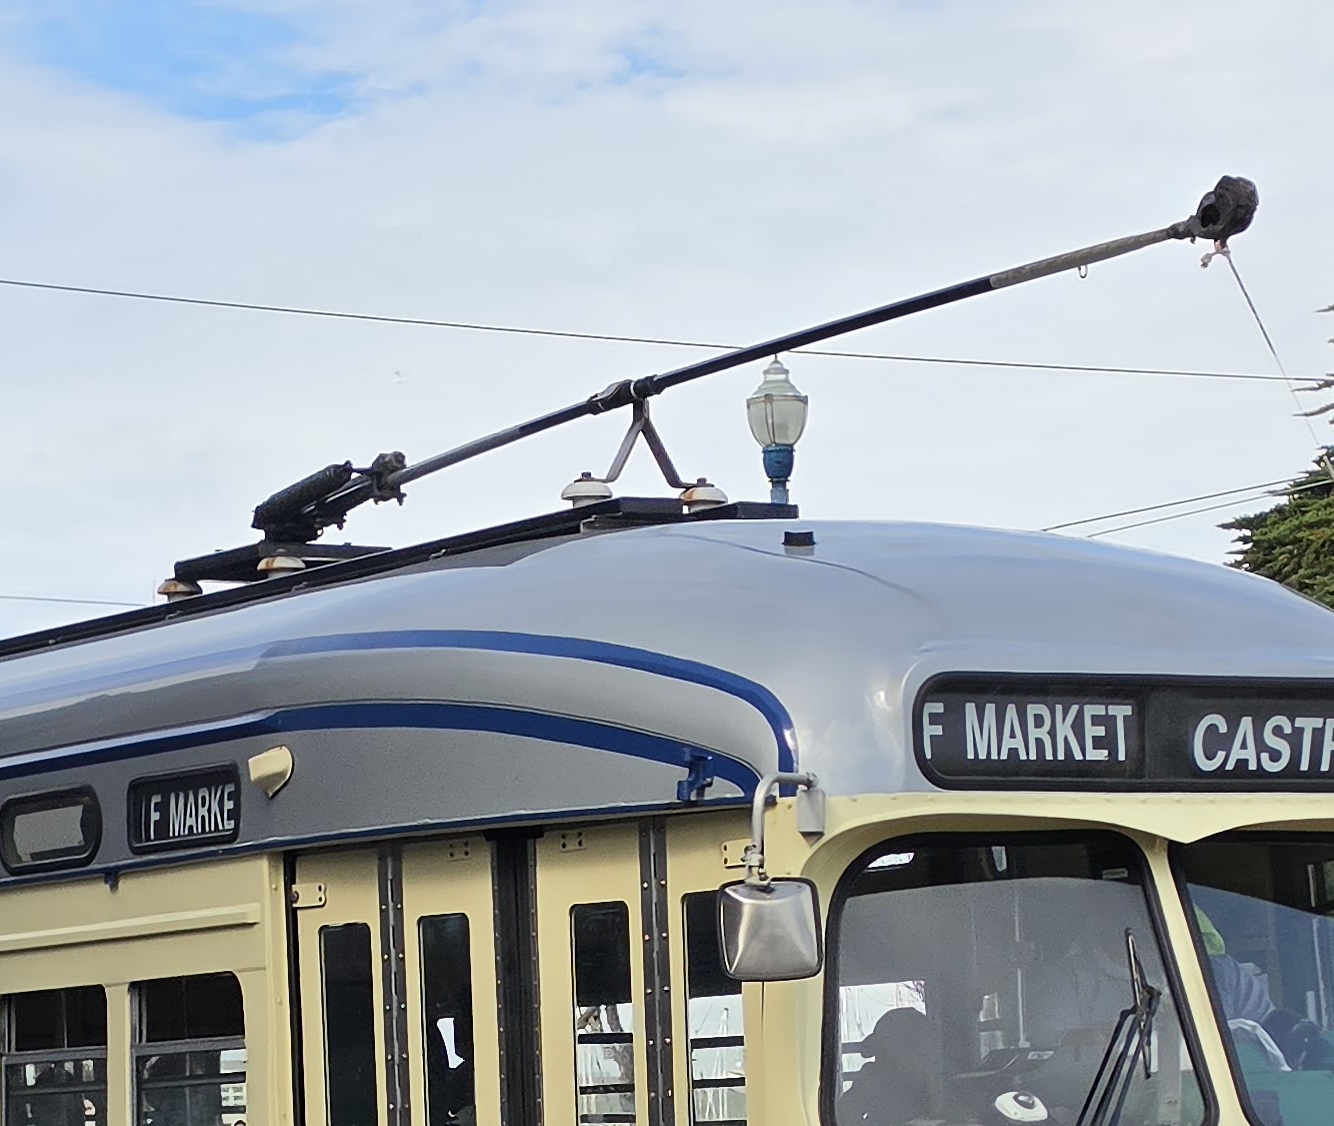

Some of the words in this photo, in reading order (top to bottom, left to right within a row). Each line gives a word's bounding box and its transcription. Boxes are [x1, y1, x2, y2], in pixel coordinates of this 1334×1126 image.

[923, 702, 944, 760] F
[965, 702, 1132, 761] MARKET
[150, 794, 162, 840] F
